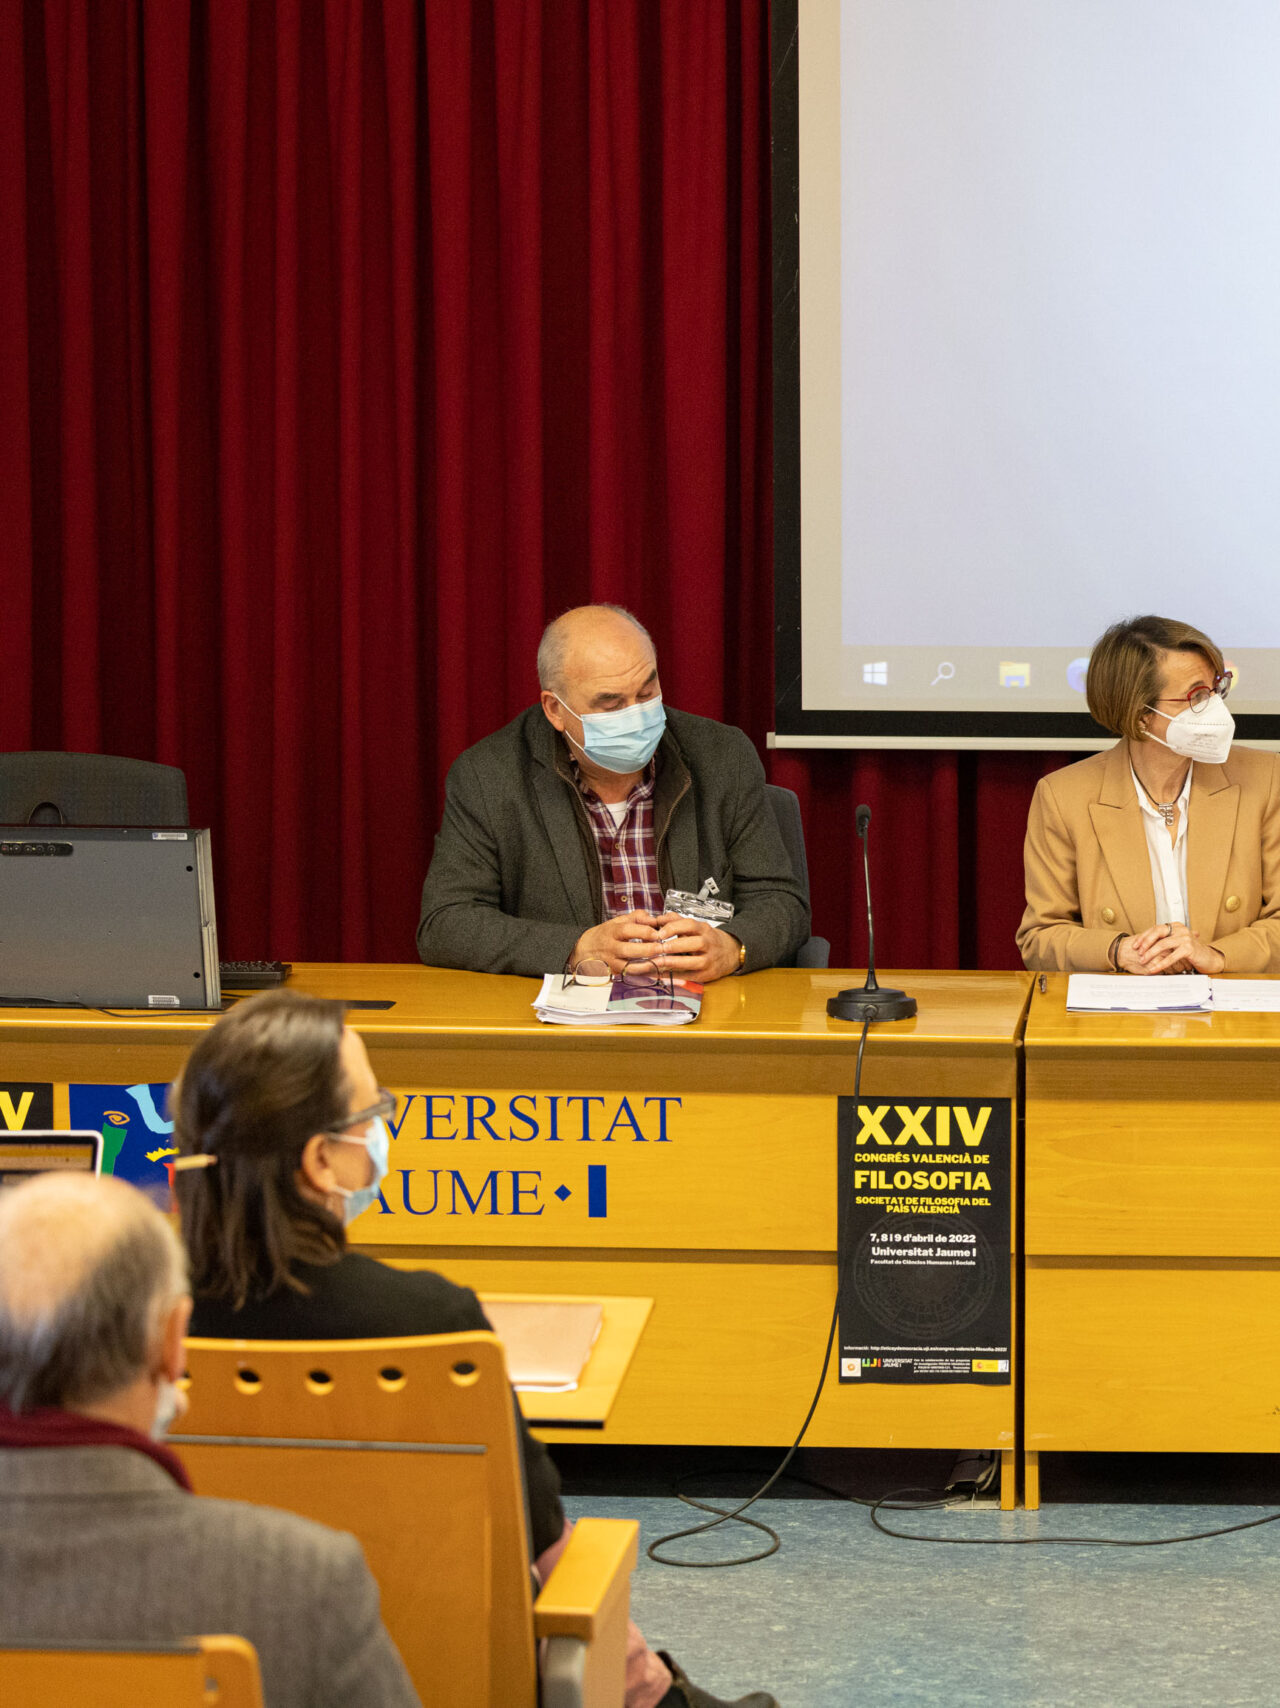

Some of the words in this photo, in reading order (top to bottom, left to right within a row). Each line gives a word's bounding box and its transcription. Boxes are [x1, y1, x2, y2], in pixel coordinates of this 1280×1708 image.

[386, 1095, 682, 1142] VERSITAT
[856, 1105, 992, 1147] XXIV
[854, 1152, 910, 1163] CONGRÉS
[912, 1152, 972, 1164] VALENCIÀ
[973, 1155, 990, 1164] DE
[854, 1170, 992, 1190] FILOSOFIA
[588, 1164, 607, 1218] I
[855, 1196, 904, 1205] SOCIETAT
[905, 1197, 919, 1205] DE
[920, 1197, 970, 1206] FILOSOFIA
[972, 1198, 991, 1206] DEL
[886, 1203, 910, 1213] PAÍS
[911, 1203, 960, 1214] VALENCIÀ
[870, 1233, 880, 1243] 7,
[881, 1233, 888, 1242] 8
[894, 1233, 902, 1242] 9
[903, 1234, 934, 1243] d'abril
[935, 1234, 947, 1243] de
[948, 1234, 976, 1243] 2022
[871, 1247, 934, 1257] Universitat
[935, 1248, 970, 1257] Jaume
[972, 1248, 977, 1257] I
[862, 1358, 881, 1368] UJI
